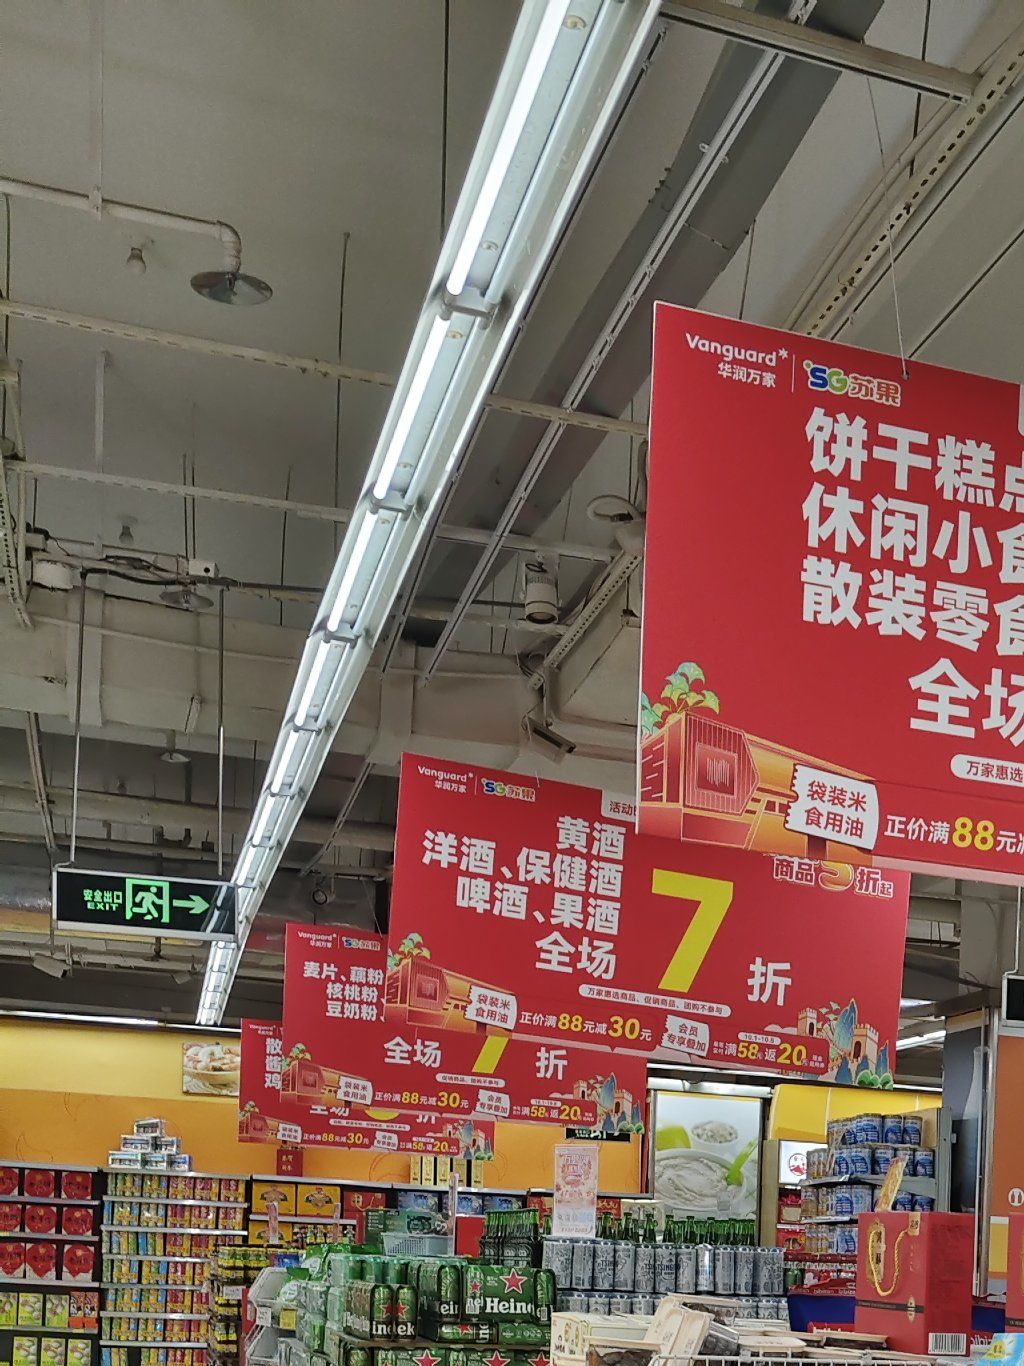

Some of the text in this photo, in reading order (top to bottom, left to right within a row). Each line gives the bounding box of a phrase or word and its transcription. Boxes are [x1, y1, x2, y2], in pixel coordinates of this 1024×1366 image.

[686, 333, 777, 367] Vanguard
[717, 362, 776, 388] 华润万家
[418, 765, 467, 783] Vanguard
[807, 780, 867, 812] 袋装米
[557, 816, 626, 860] 黄酒
[804, 806, 865, 839] 食用油
[422, 829, 624, 898] 洋酒、保健酒
[83, 888, 123, 904] 安全出口
[87, 902, 119, 911] EXIT
[456, 876, 621, 935] 啤酒、果酒
[651, 868, 734, 993] 7
[535, 931, 617, 980] 全场
[747, 956, 793, 1006] 折
[475, 1007, 509, 1024] 食用油
[478, 992, 511, 1011] 袋装米
[678, 1022, 698, 1037] 会员
[384, 1036, 442, 1068] 全场
[535, 1047, 568, 1081] 折
